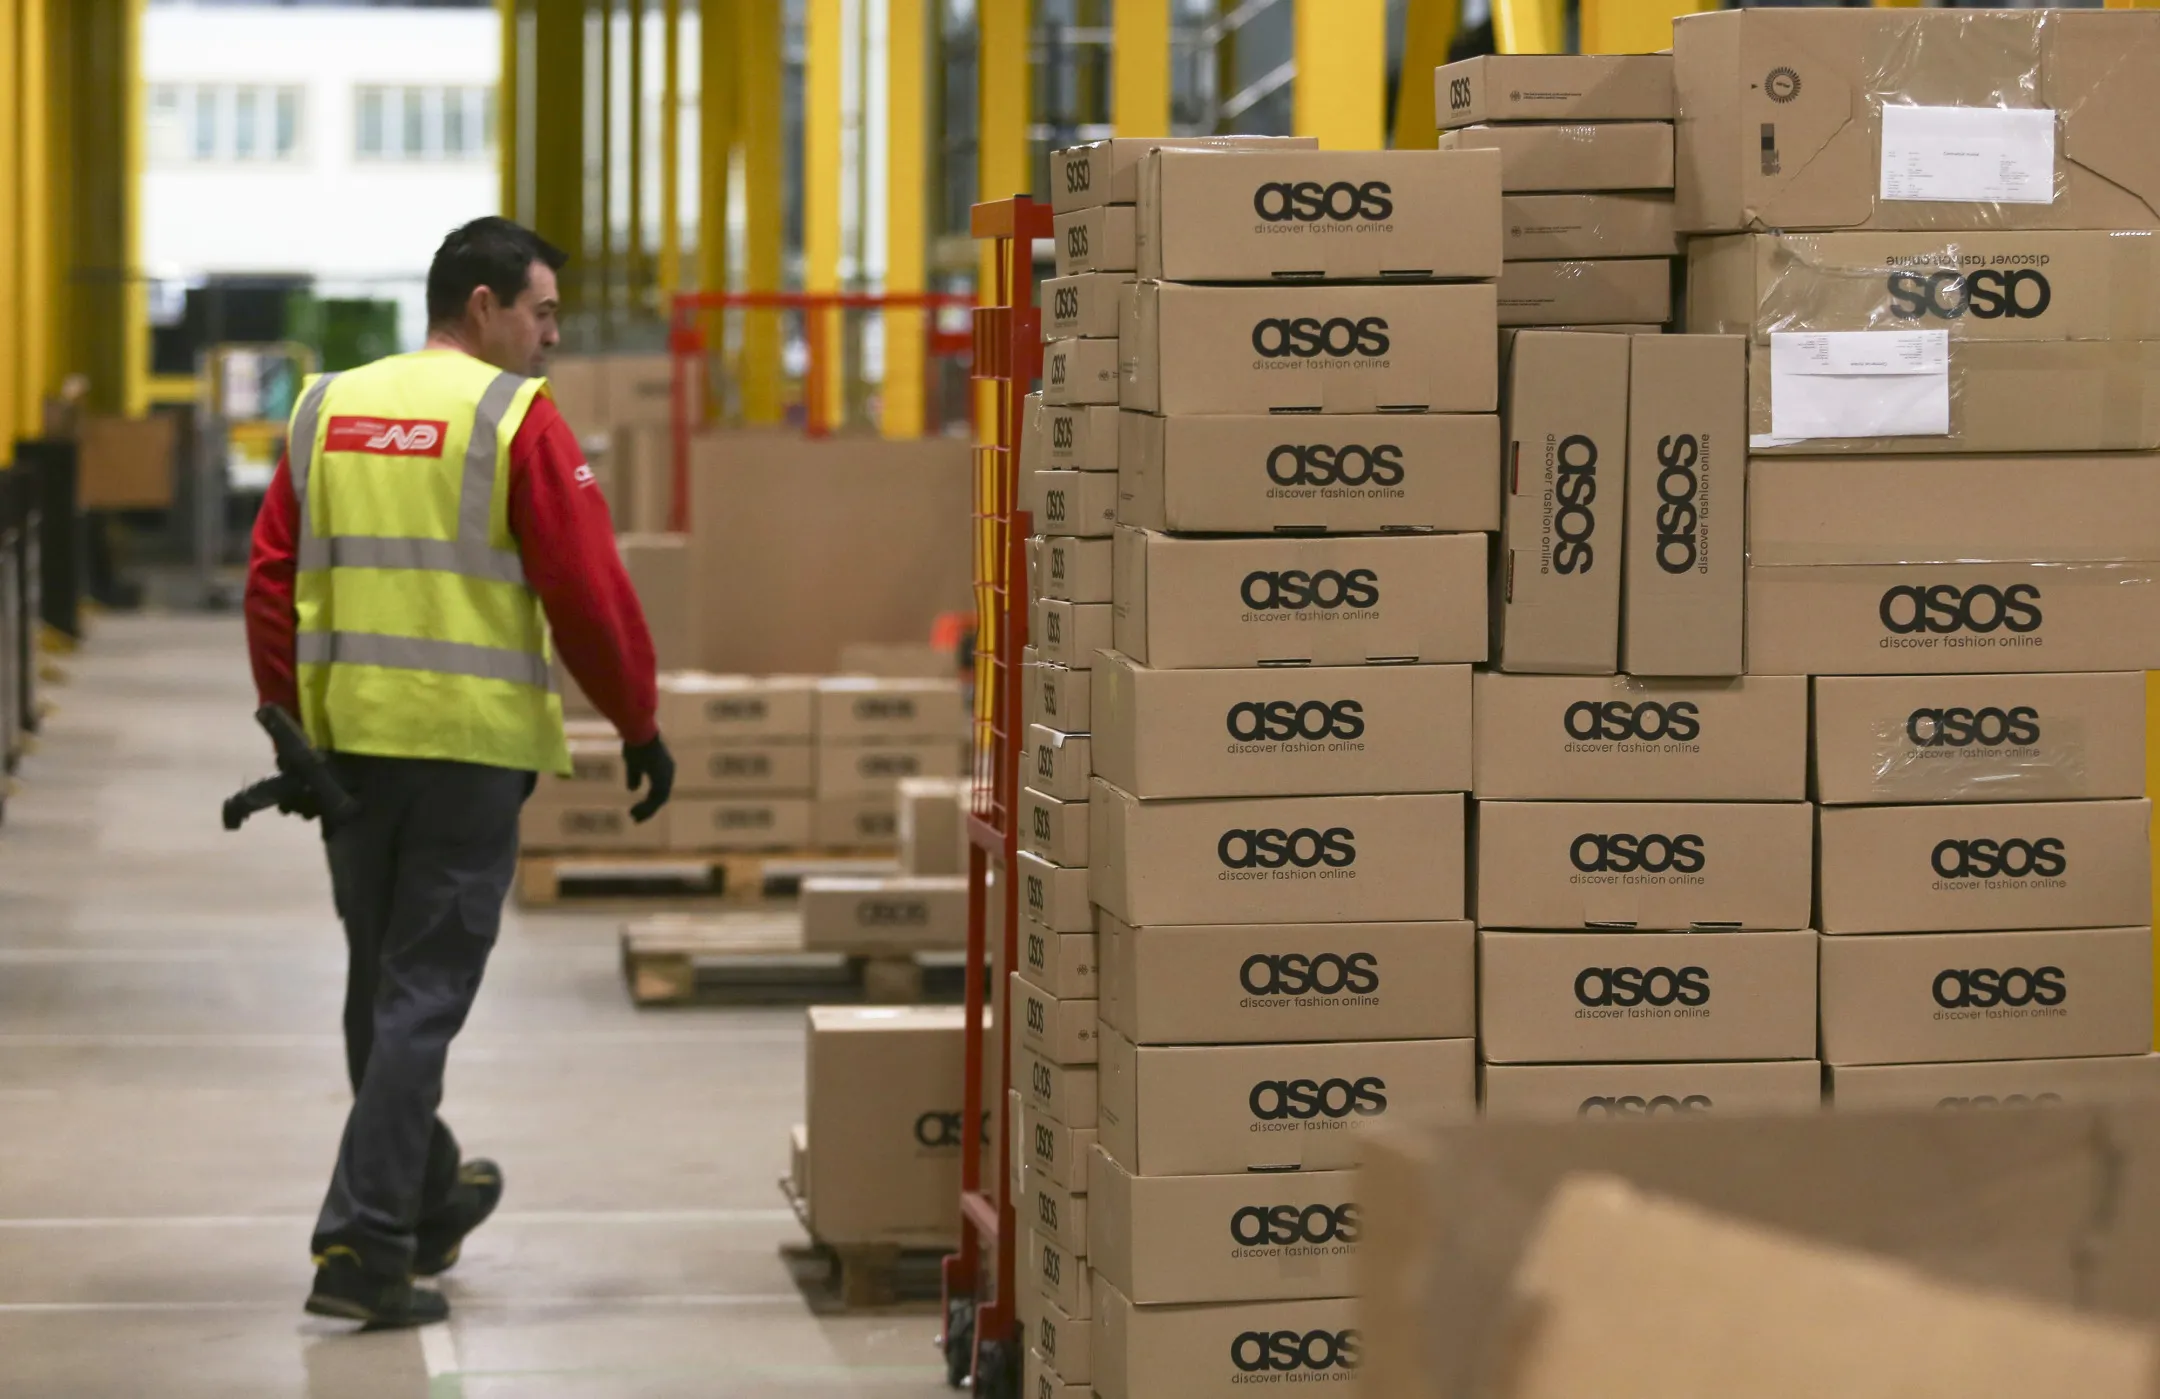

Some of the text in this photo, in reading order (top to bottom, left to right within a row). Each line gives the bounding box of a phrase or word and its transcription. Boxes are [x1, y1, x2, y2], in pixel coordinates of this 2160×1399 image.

[1450, 77, 1471, 110] asos
[1254, 182, 1393, 222] asos
[1255, 222, 1393, 234] discover fashion online
[1990, 255, 2050, 267] discover
[1054, 286, 1078, 320] asos
[1887, 267, 2052, 320] asos
[1252, 317, 1389, 358] asos
[1252, 358, 1390, 370] discover fashion online
[1267, 444, 1404, 486] asos
[1046, 490, 1065, 521] asos
[1266, 488, 1405, 498] discover fashion online
[1541, 434, 1556, 574] discover fashion online
[1552, 434, 1598, 575] asos
[1656, 433, 1698, 575] asos
[1698, 434, 1709, 574] discover fashion online
[1241, 569, 1379, 610] asos
[1241, 610, 1379, 622] discover fashion online
[1879, 583, 2042, 634] asos
[1880, 635, 2042, 648] discover fashion online
[1227, 700, 1364, 742] asos
[1563, 701, 1700, 741] asos
[1907, 706, 2040, 747] asos
[1228, 741, 1364, 753] discover fashion online
[1564, 742, 1700, 753] discover fashion online
[1960, 748, 2003, 758] fashion
[2005, 748, 2040, 758] online
[1218, 827, 1355, 869] asos
[1569, 833, 1705, 873] asos
[1931, 837, 2067, 879] asos
[1218, 868, 1356, 880] discover fashion online
[1570, 874, 1705, 885] discover fashion online
[1932, 878, 2067, 890] discover fashion online
[1240, 952, 1378, 995] asos
[1574, 966, 1710, 1007] asos
[1932, 966, 2067, 1008] asos
[1240, 995, 1379, 1008] discover fashion online
[1575, 1008, 1710, 1019] discover fashion online
[1933, 1009, 2067, 1020] discover fashion online
[1249, 1077, 1387, 1120] asos
[1250, 1122, 1300, 1132] discover
[1304, 1120, 1348, 1131] fashion
[1232, 1248, 1280, 1258] discover
[1285, 1246, 1329, 1257] fashion
[1232, 1374, 1280, 1384] discover
[1285, 1372, 1329, 1382] fashion
